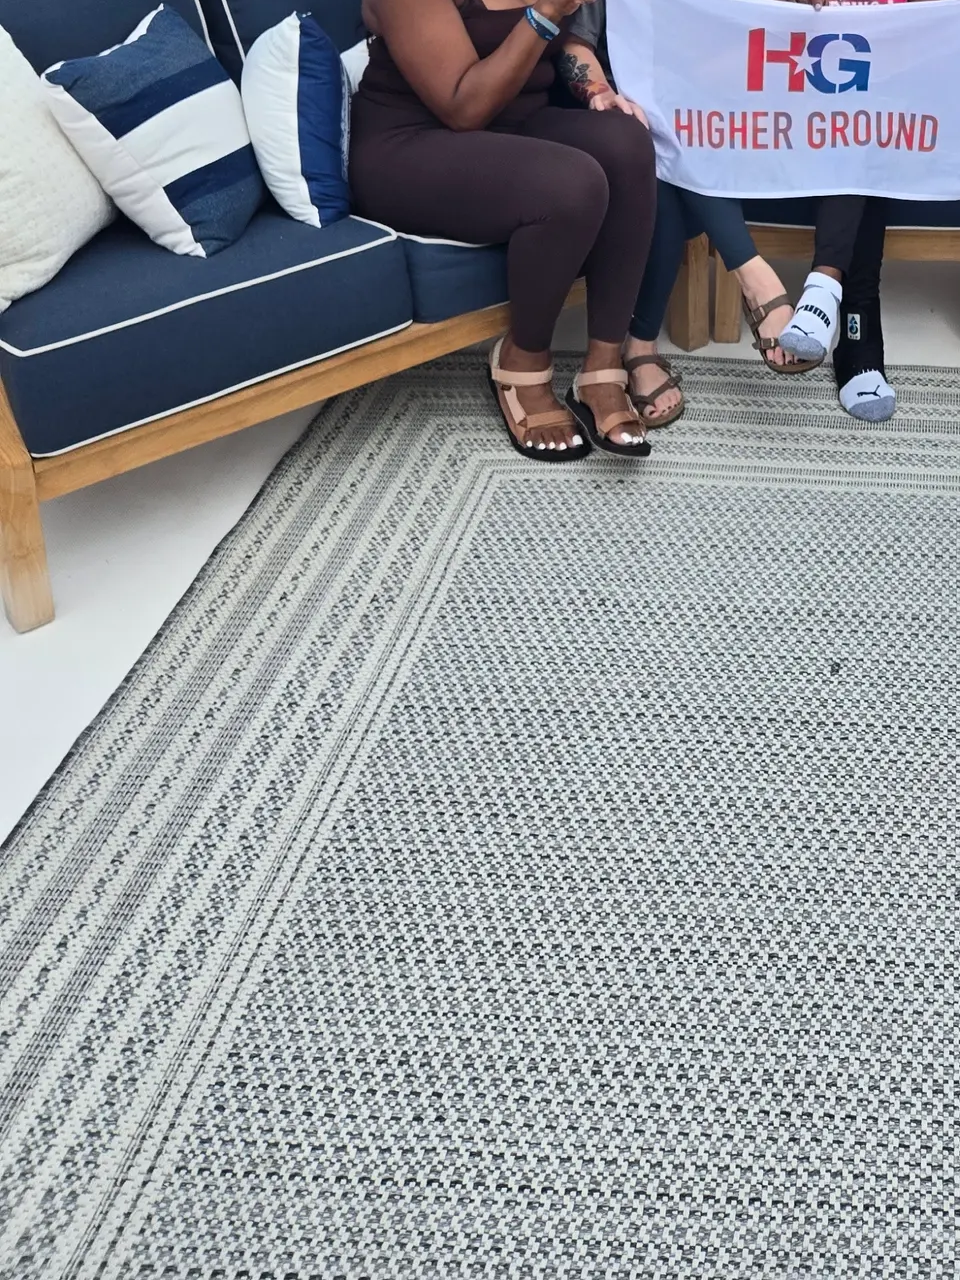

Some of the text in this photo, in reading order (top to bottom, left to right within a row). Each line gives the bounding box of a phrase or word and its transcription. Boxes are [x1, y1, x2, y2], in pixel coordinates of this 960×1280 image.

[746, 27, 872, 94] HG
[674, 108, 939, 153] HIGHER GROUND
